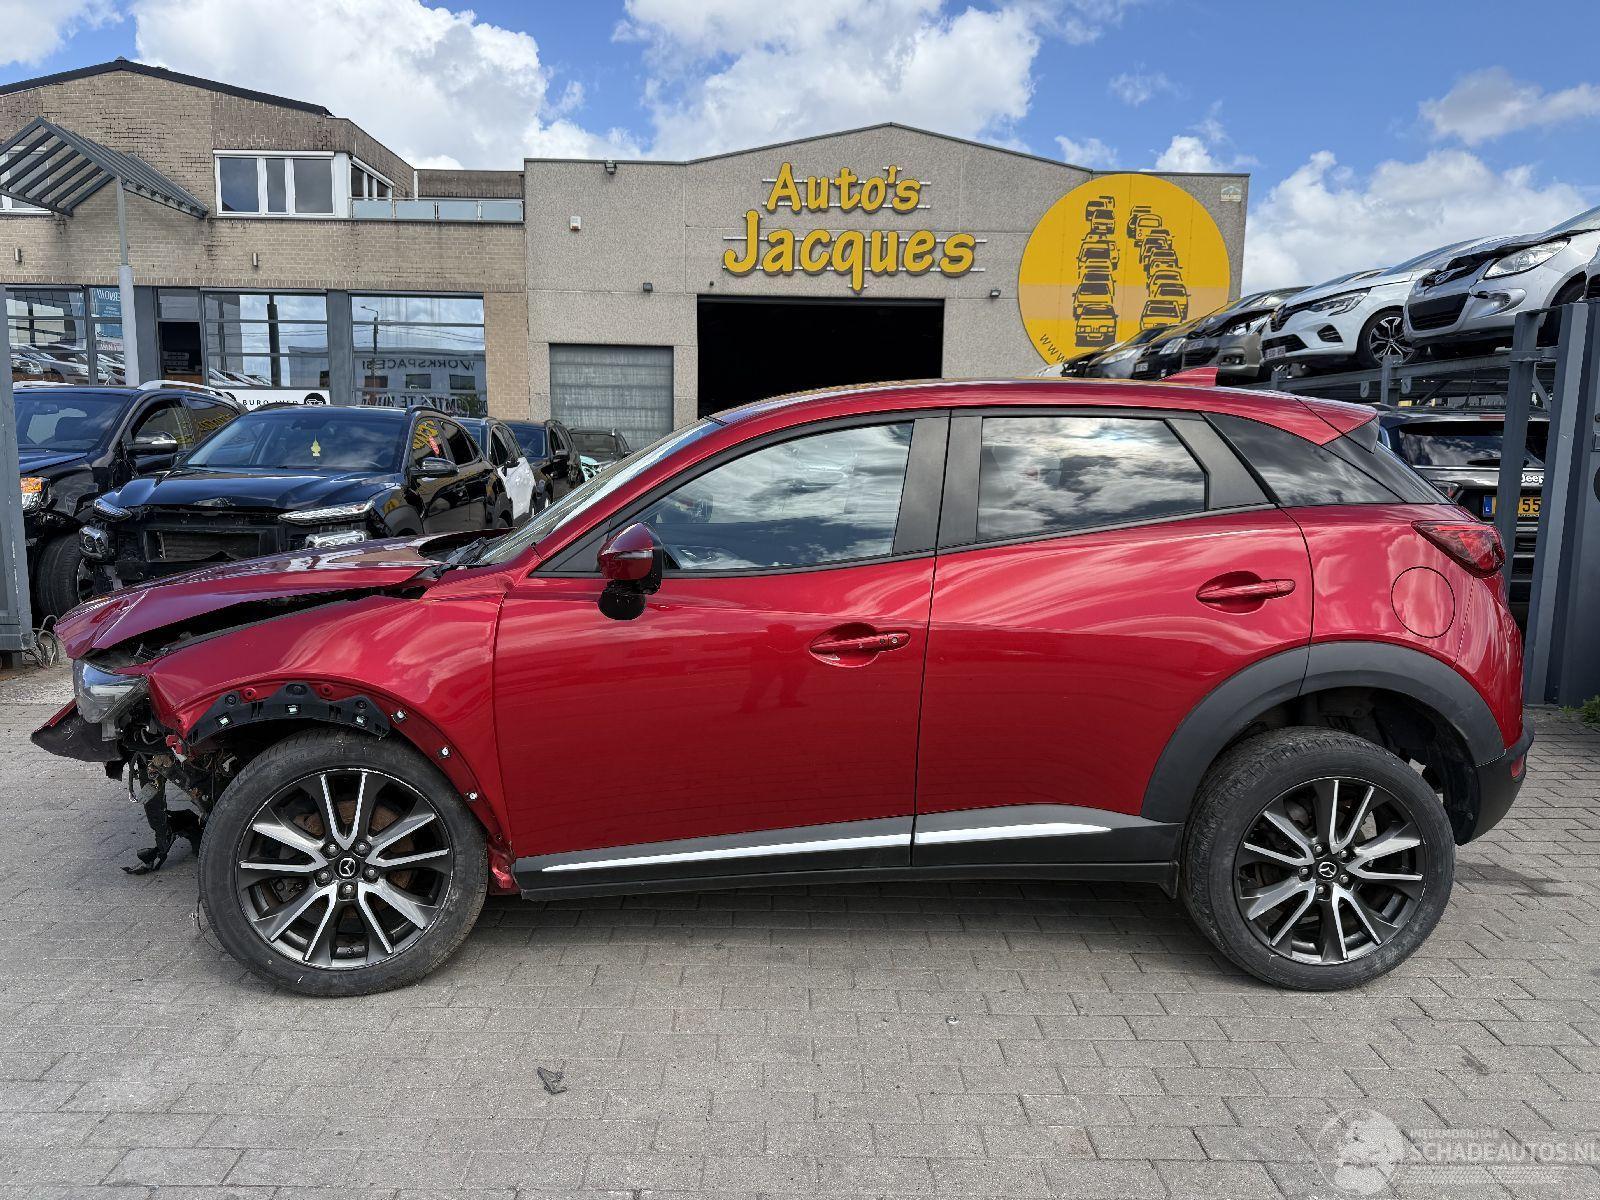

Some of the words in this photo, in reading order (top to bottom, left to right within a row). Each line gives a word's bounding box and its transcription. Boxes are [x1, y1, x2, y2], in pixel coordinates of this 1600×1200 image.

[767, 162, 921, 213] Auto's
[723, 209, 977, 293] Jacques
[1521, 473, 1544, 484] Jeep
